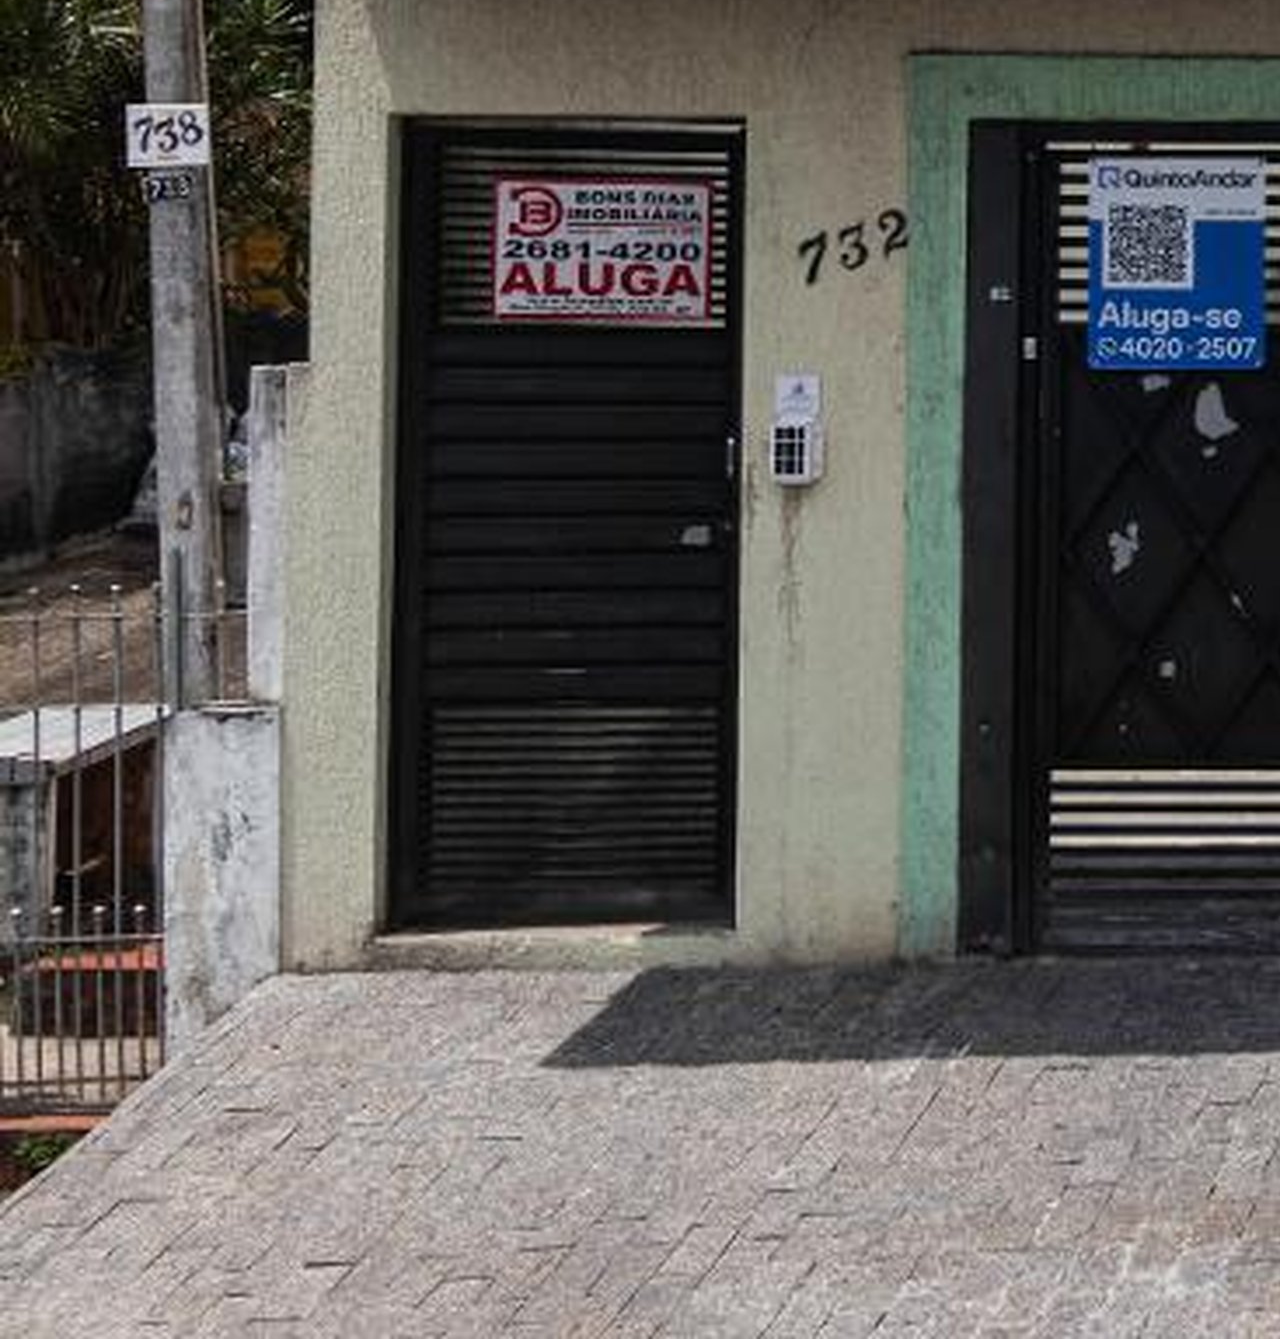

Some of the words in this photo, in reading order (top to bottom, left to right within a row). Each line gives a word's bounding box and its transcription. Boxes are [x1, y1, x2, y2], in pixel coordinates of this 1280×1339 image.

[134, 110, 204, 154] 738
[1124, 169, 1257, 189] QuintoAndar
[503, 240, 701, 261] 2681-4200
[799, 210, 908, 285] 732
[501, 262, 700, 297] ALUGA
[1099, 301, 1242, 335] Aluga-se
